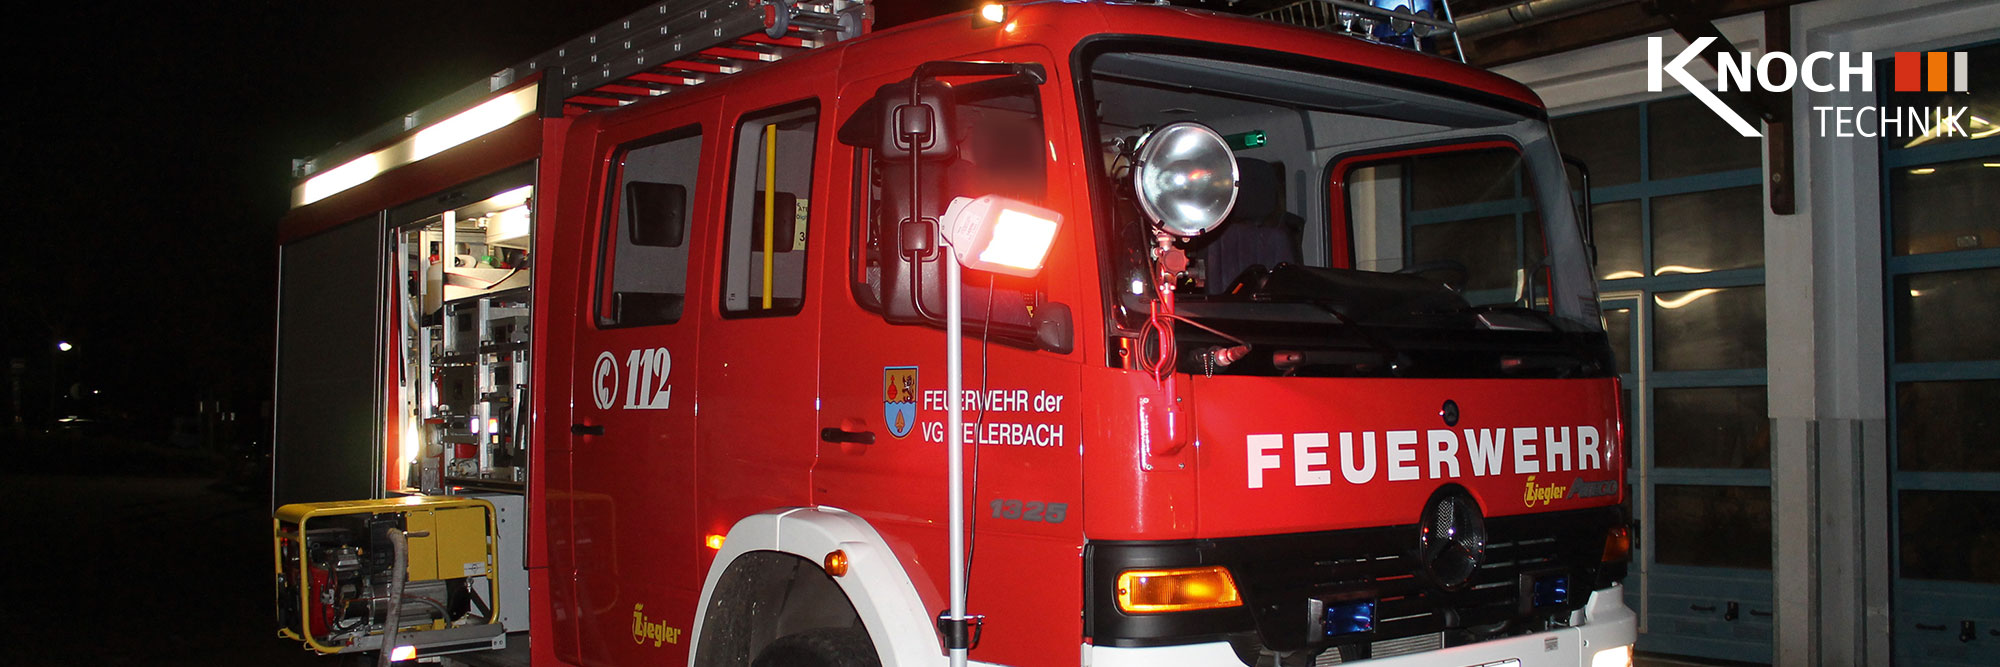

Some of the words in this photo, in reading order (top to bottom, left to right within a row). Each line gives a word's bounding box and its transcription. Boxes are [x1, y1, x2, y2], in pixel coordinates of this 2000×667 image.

[623, 347, 672, 410] 112
[1033, 390, 1064, 412] der
[922, 421, 944, 443] VG
[961, 422, 1064, 447] ELERBACH
[1246, 425, 1601, 489] FEUERWEHR
[1524, 475, 1567, 508] Ziegler
[988, 498, 1069, 524] 1325
[632, 603, 681, 647] Ziegler
